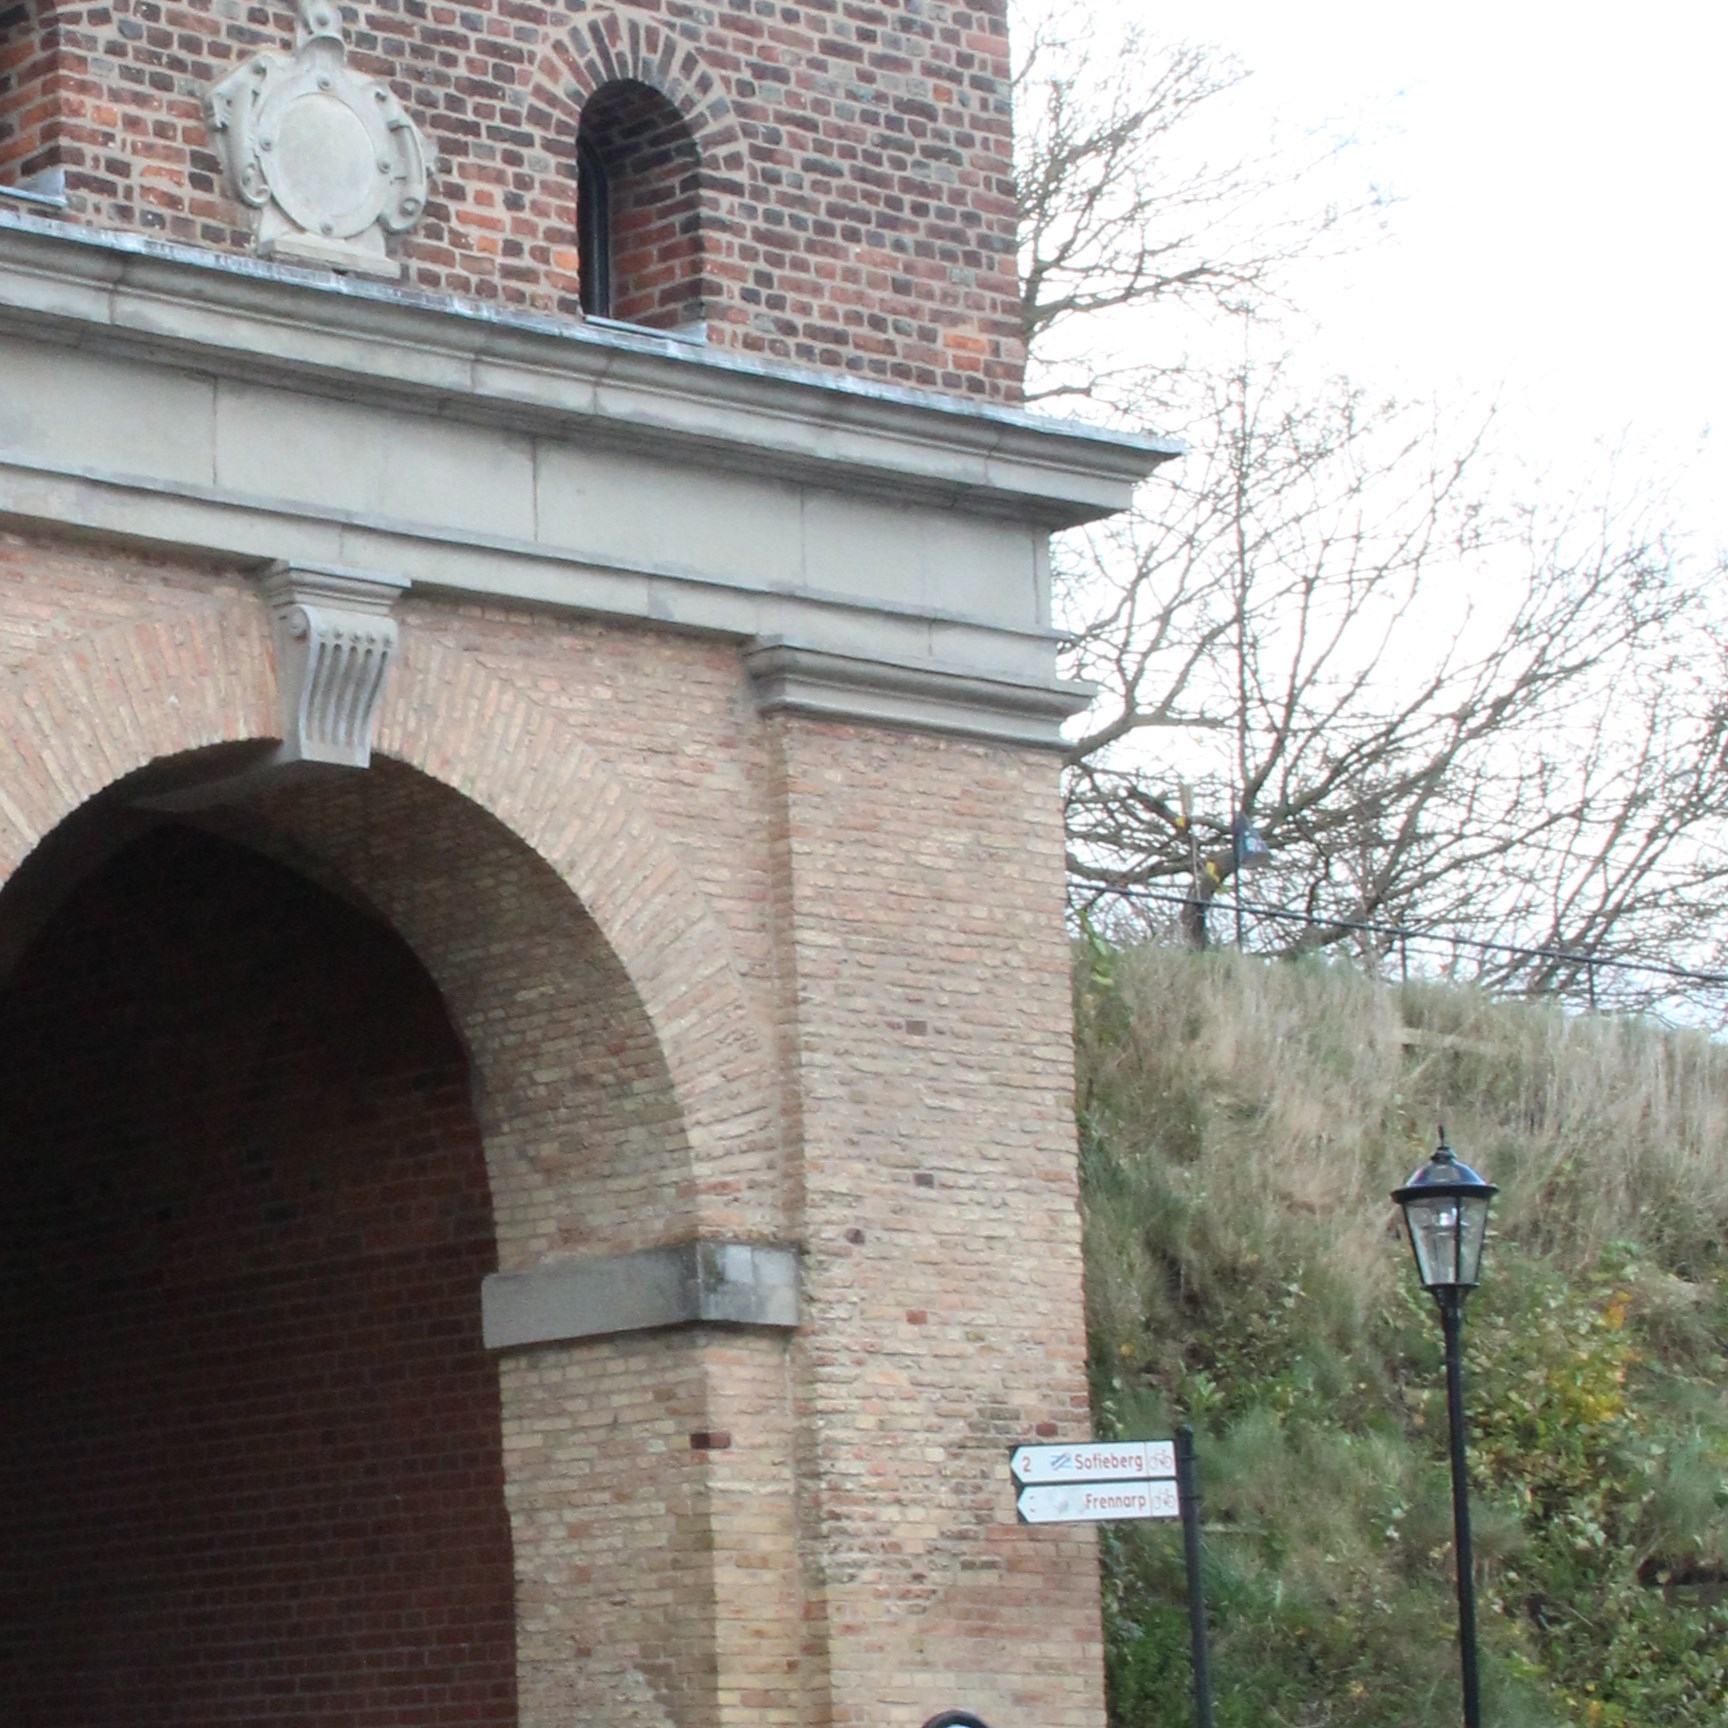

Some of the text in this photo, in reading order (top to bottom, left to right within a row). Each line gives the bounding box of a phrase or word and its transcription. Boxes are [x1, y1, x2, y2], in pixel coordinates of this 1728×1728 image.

[1022, 1451, 1144, 1473] 2 Sofieberg
[1085, 1492, 1146, 1510] Frennarp
